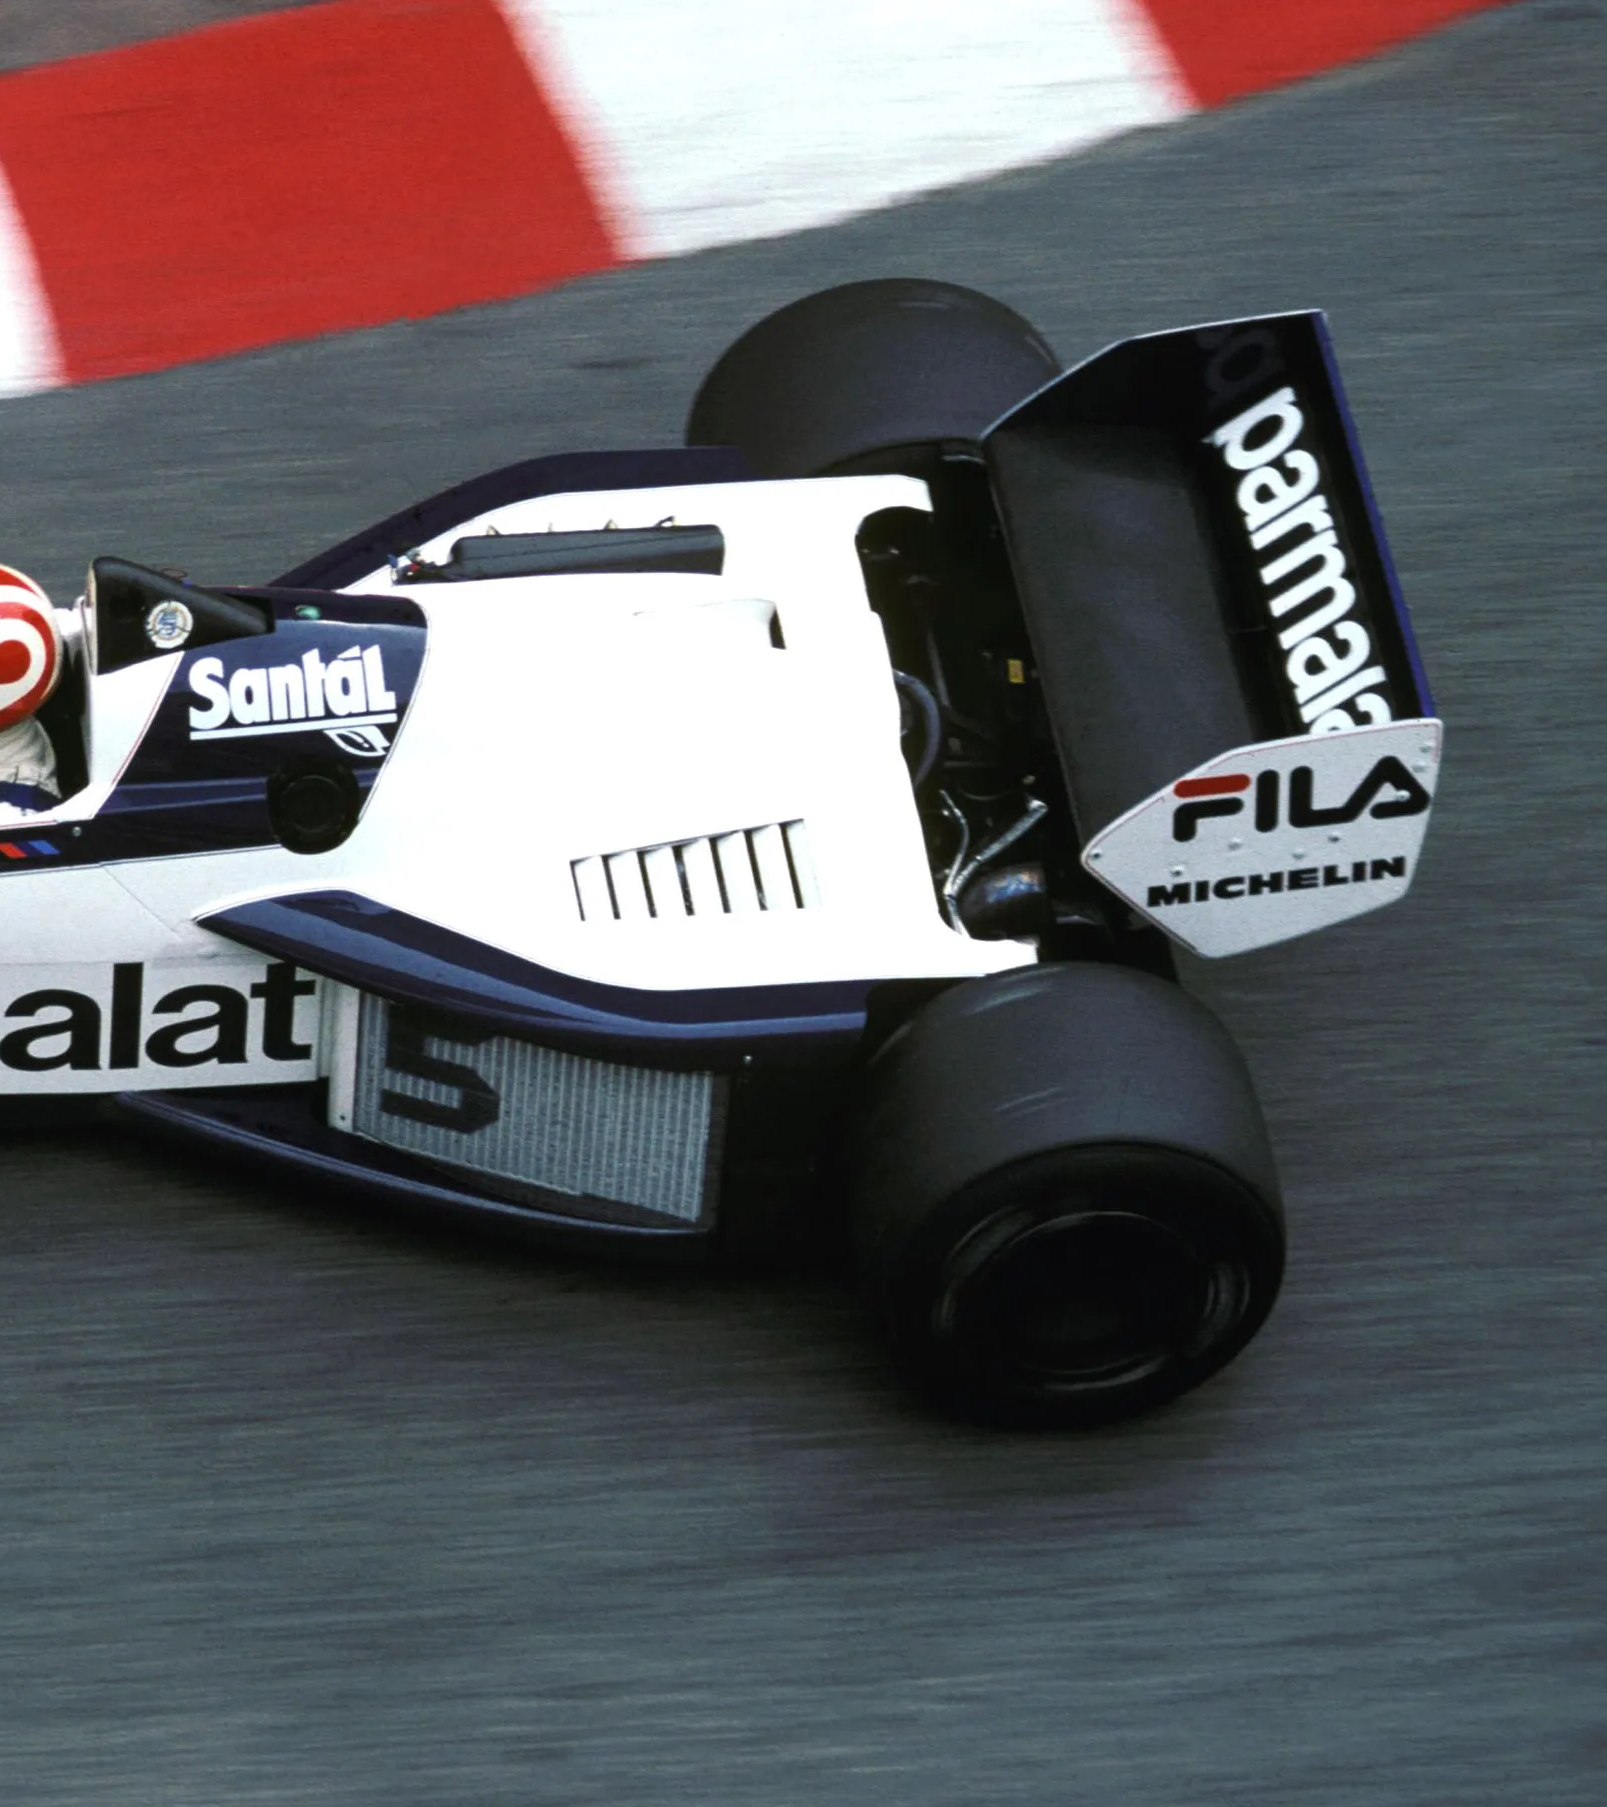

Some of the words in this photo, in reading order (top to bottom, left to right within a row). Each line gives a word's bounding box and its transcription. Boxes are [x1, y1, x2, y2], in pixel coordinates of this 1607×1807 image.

[1206, 386, 1392, 734] parmala
[1172, 755, 1431, 843] FILA
[1146, 855, 1406, 908] MICHELIN
[379, 1003, 501, 1135] 5
